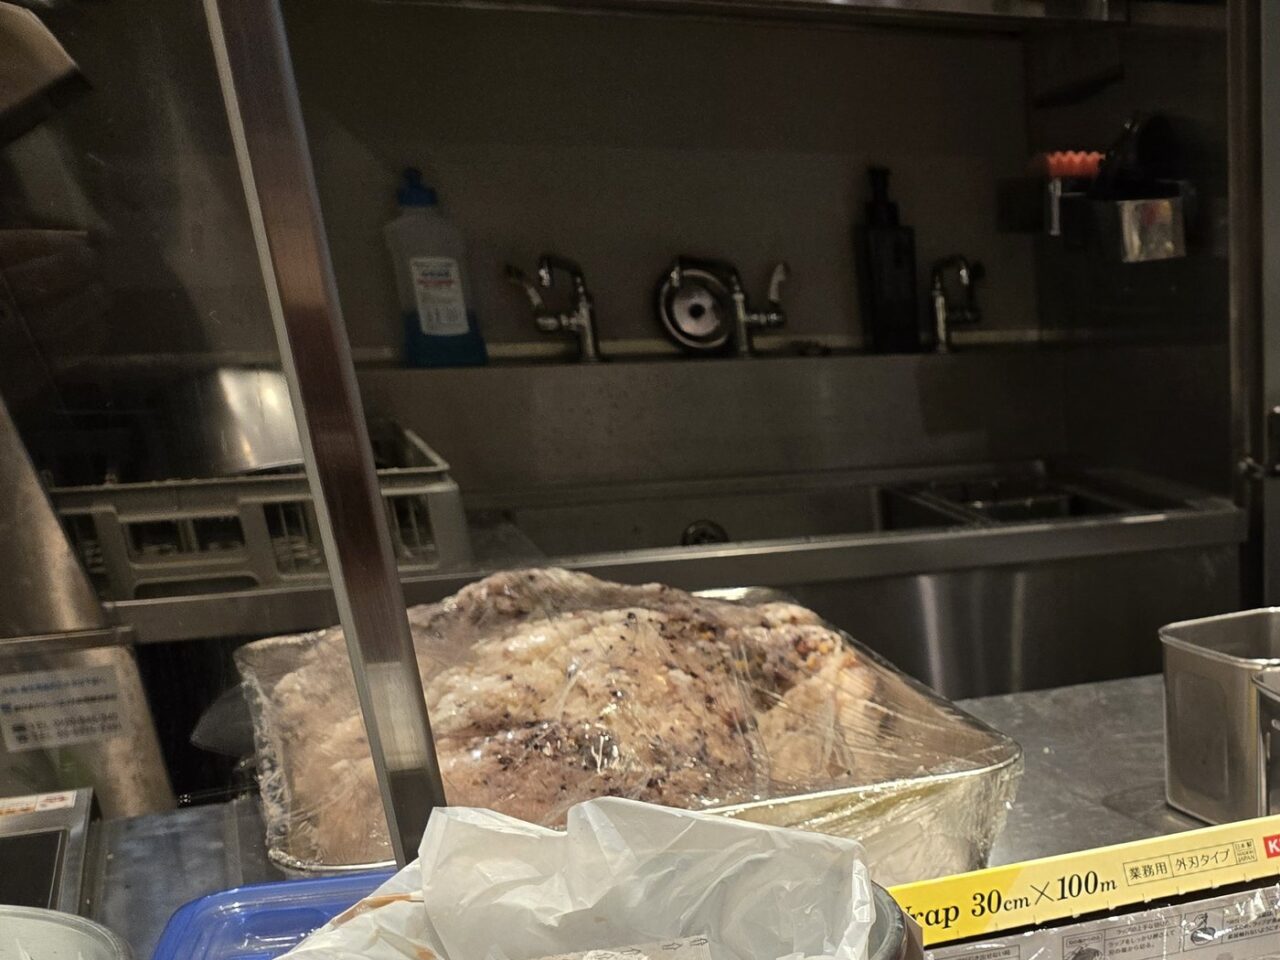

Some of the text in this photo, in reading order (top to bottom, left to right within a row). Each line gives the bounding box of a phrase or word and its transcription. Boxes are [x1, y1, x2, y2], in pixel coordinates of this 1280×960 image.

[1129, 850, 1230, 880] 業務用 外刃タイプ
